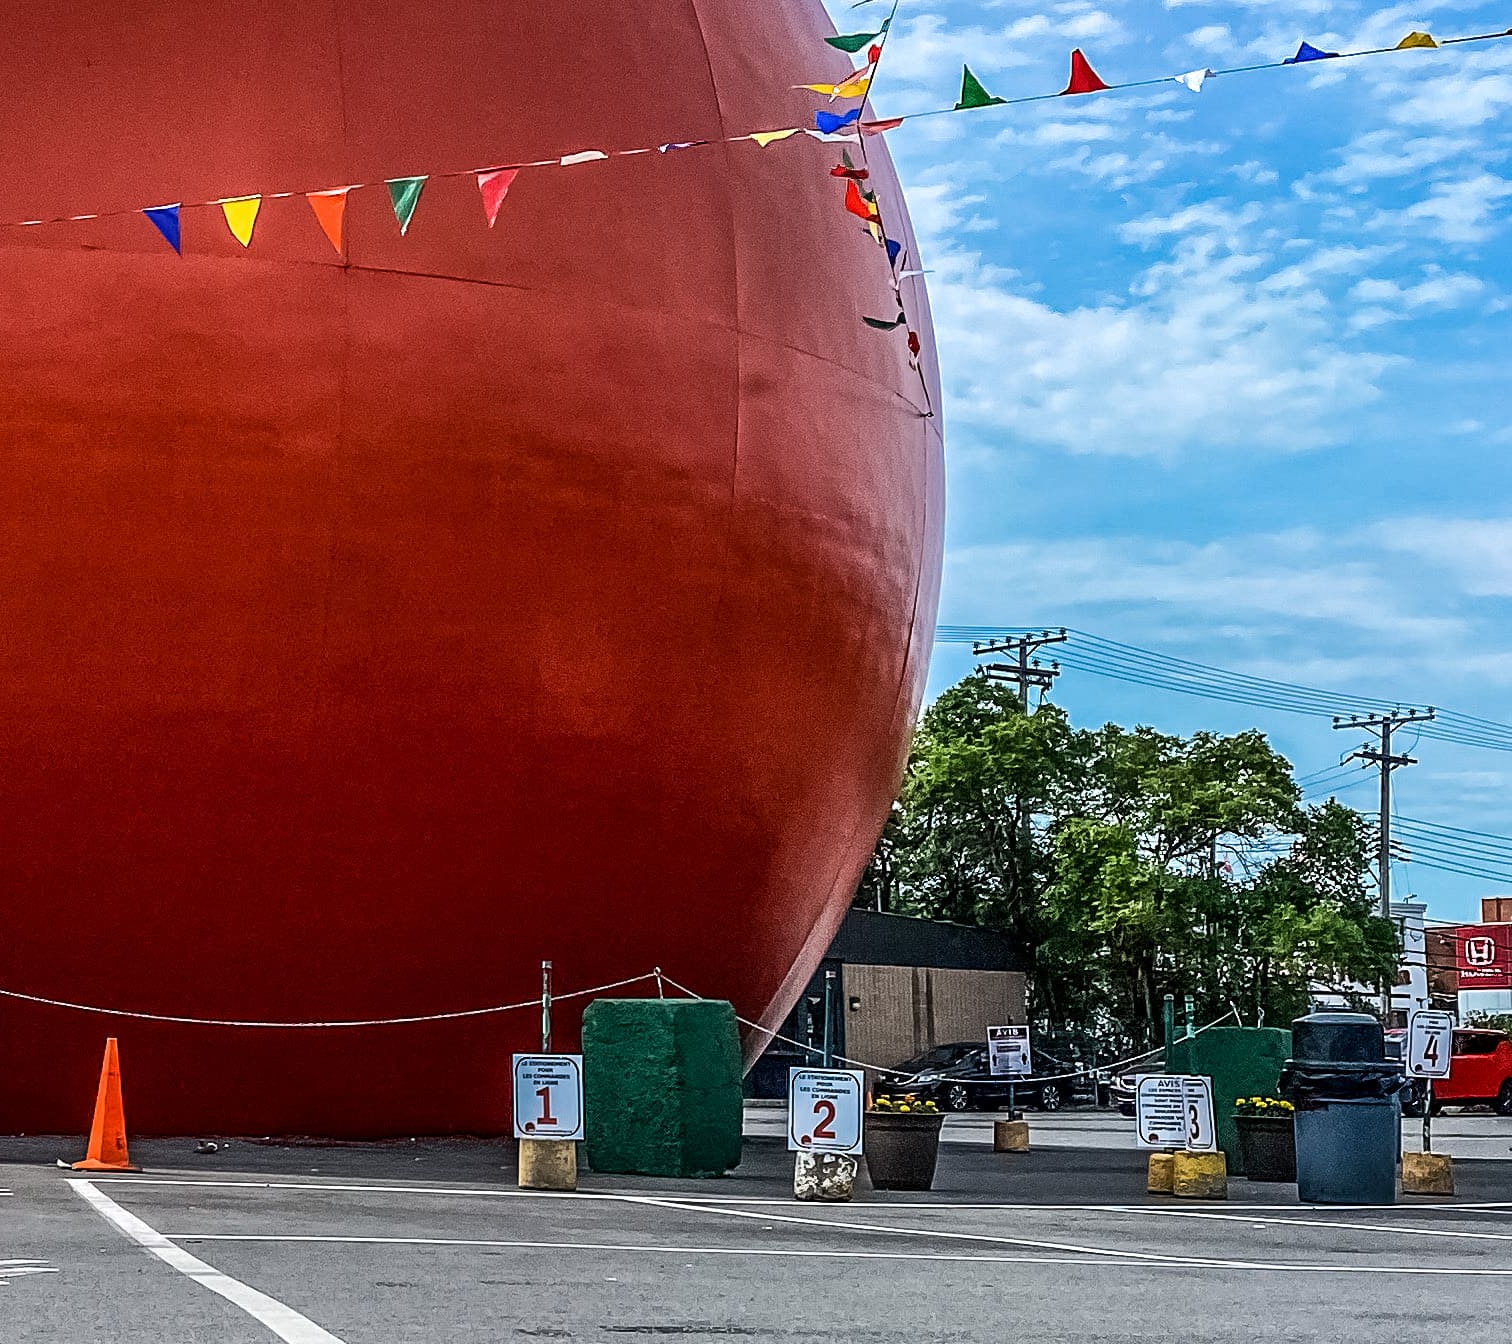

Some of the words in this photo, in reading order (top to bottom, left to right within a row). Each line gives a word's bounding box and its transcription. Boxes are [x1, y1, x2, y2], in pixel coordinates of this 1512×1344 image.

[1423, 1034, 1439, 1068] 4
[1157, 1079, 1180, 1088] AVIS
[535, 1085, 558, 1125] 1
[813, 1099, 836, 1139] 2
[1188, 1104, 1200, 1140] 3
